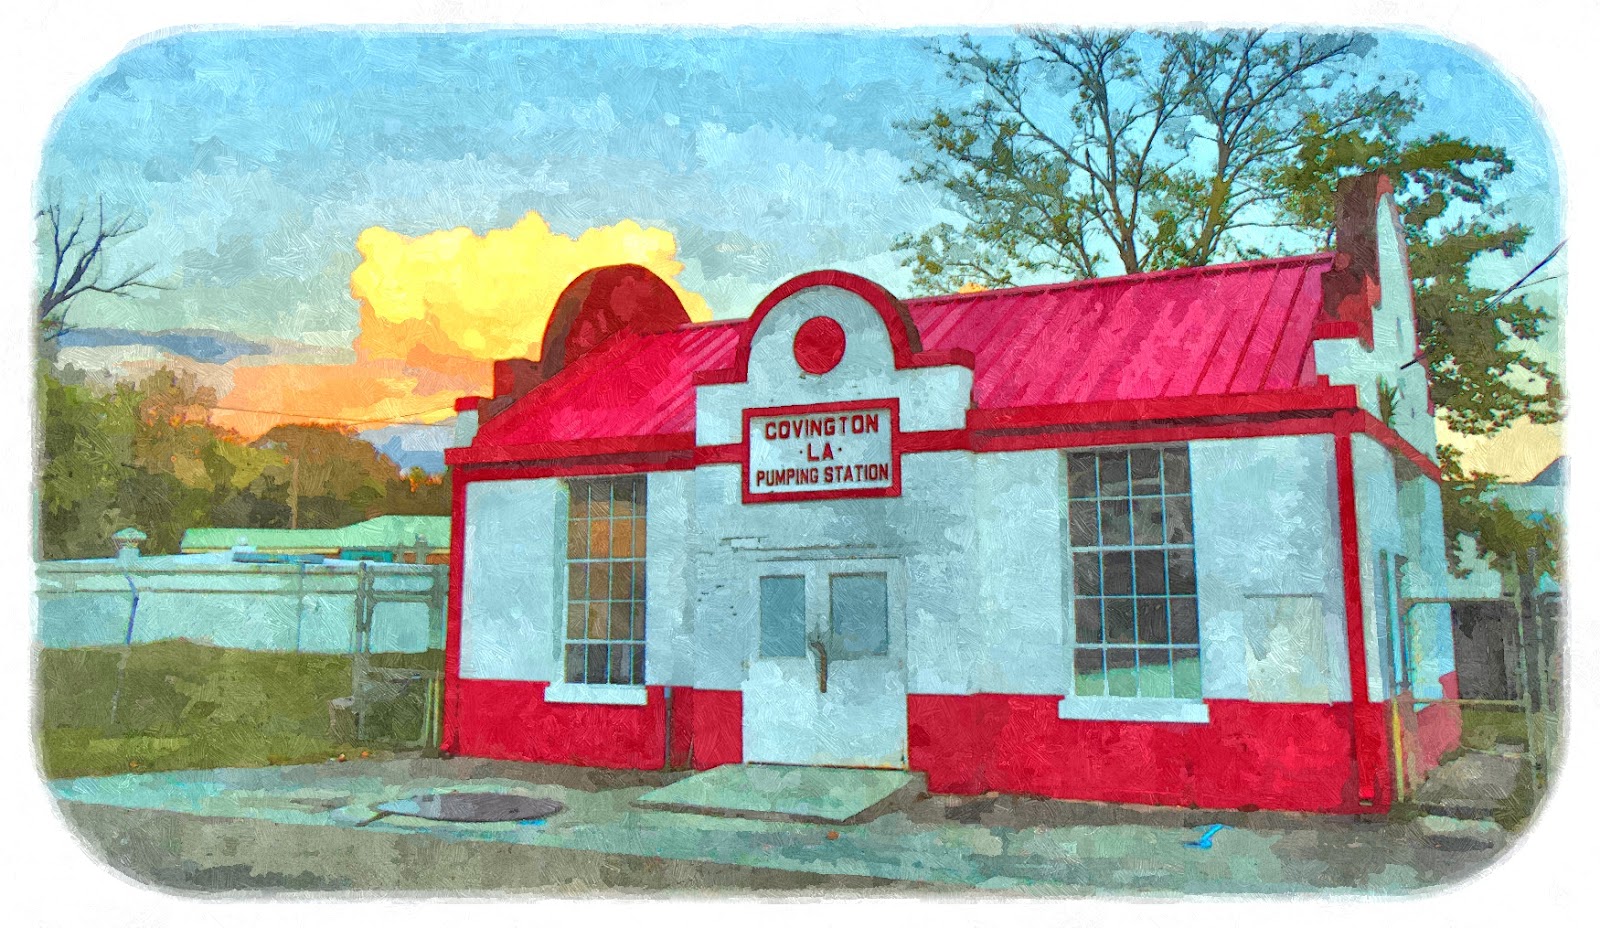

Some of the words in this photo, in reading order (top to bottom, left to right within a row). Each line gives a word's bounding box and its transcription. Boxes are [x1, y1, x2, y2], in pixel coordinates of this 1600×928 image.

[765, 414, 879, 440] COVINGTON
[756, 467, 819, 487] PUMPING
[824, 463, 889, 483] STATION
